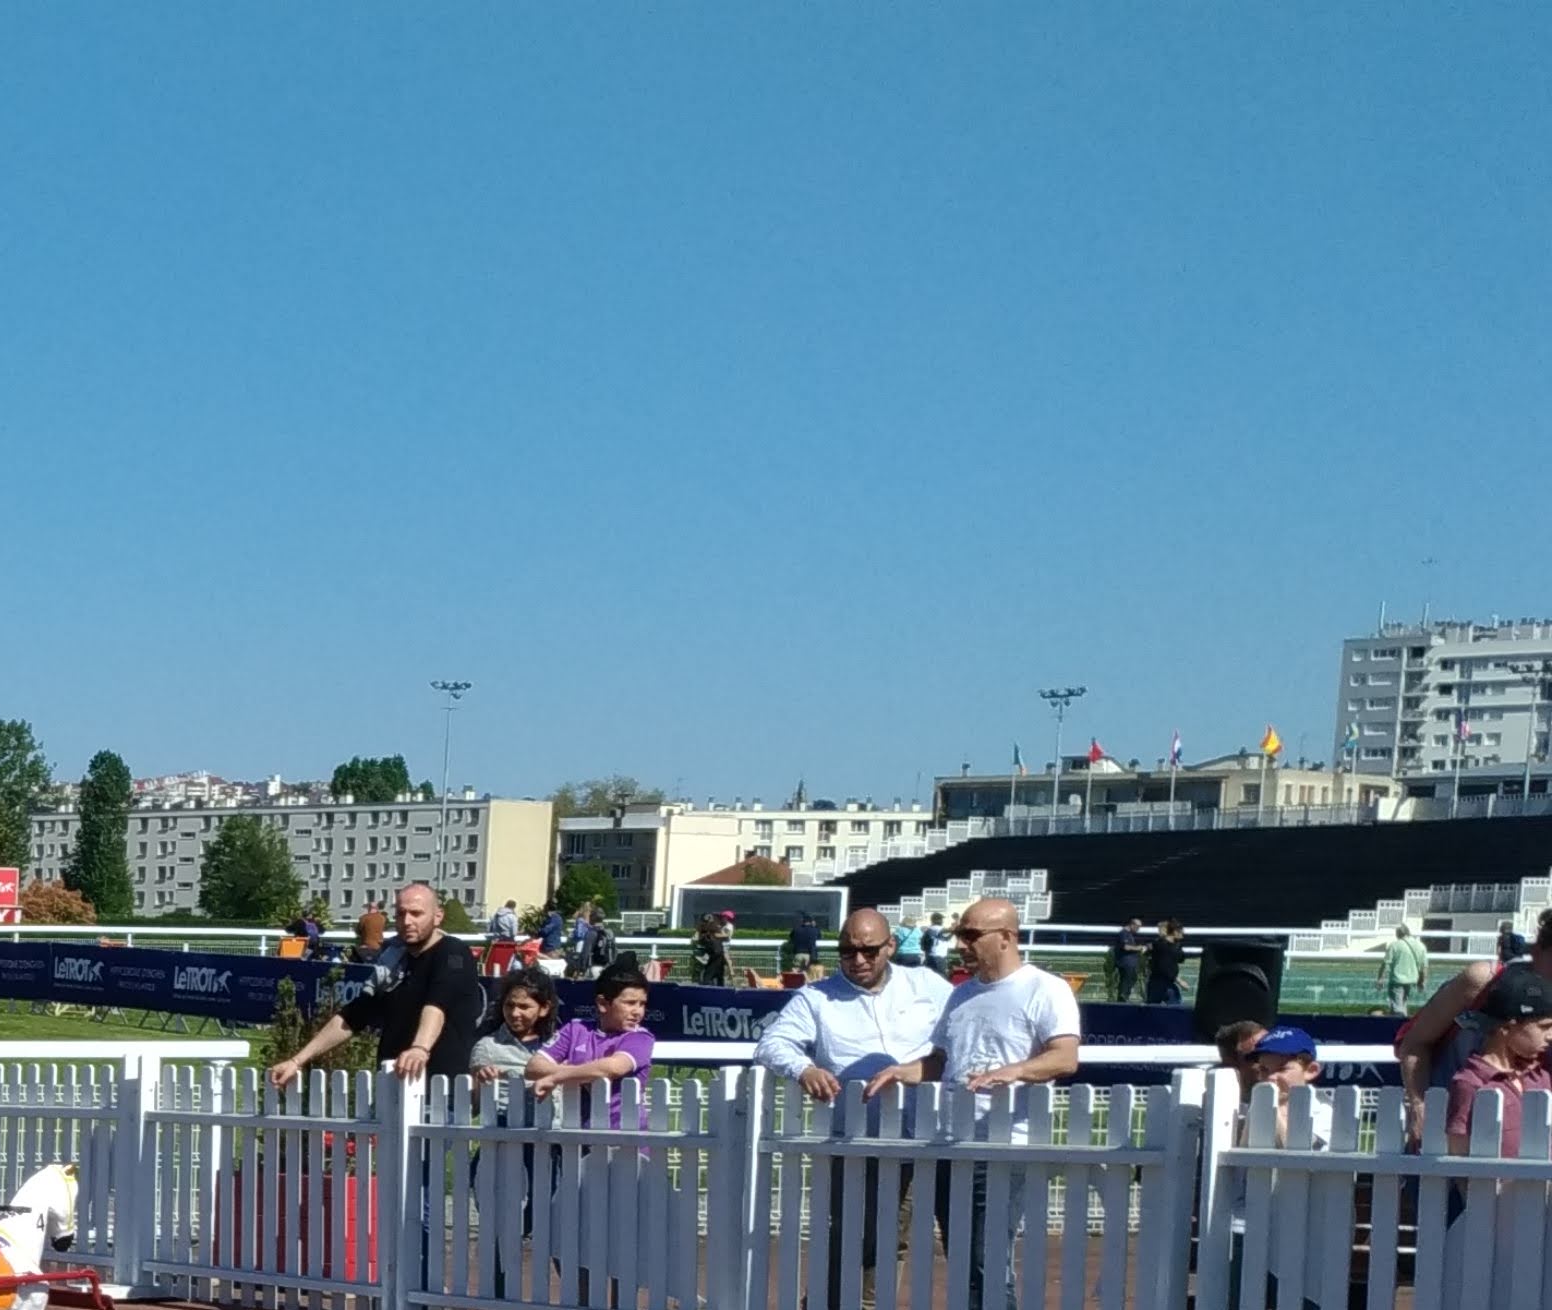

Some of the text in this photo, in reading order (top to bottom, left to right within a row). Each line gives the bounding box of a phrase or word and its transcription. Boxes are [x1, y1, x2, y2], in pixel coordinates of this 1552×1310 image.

[54, 956, 90, 981] LeTROT
[174, 965, 215, 991] LeTROT
[682, 1004, 753, 1039] LeTROT
[36, 1213, 45, 1232] 4
